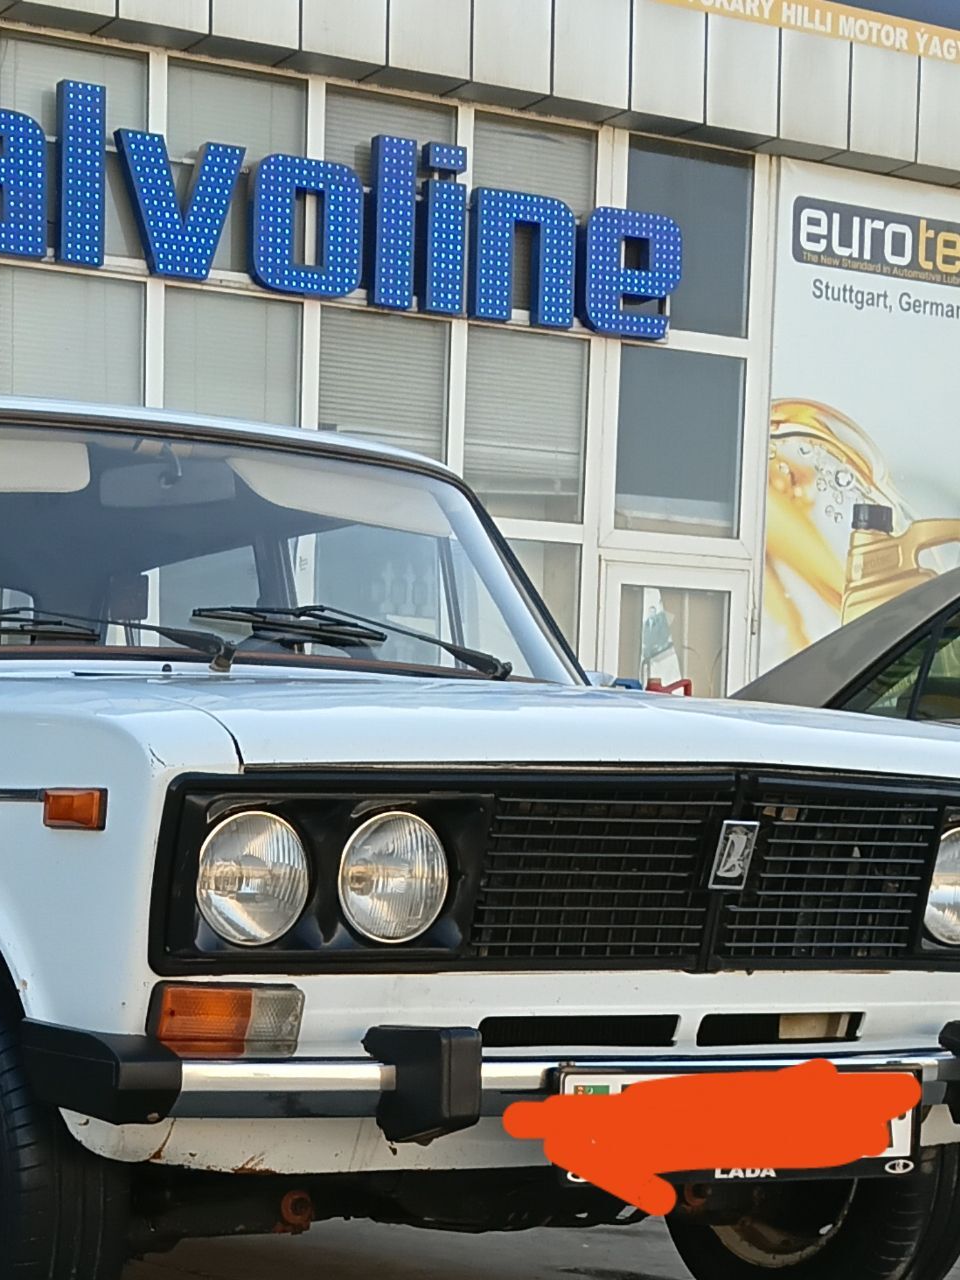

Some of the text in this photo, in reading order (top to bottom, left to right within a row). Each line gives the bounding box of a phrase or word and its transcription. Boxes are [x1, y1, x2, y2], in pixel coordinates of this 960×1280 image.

[781, 6, 832, 33] HILLI
[839, 14, 908, 50] MOTOR
[916, 27, 960, 60] ÝAG
[802, 251, 818, 262] The
[820, 254, 839, 266] New
[841, 257, 881, 273] Standard
[883, 263, 890, 273] in
[892, 266, 941, 282] Automotive
[812, 278, 893, 313] Stuttgart,
